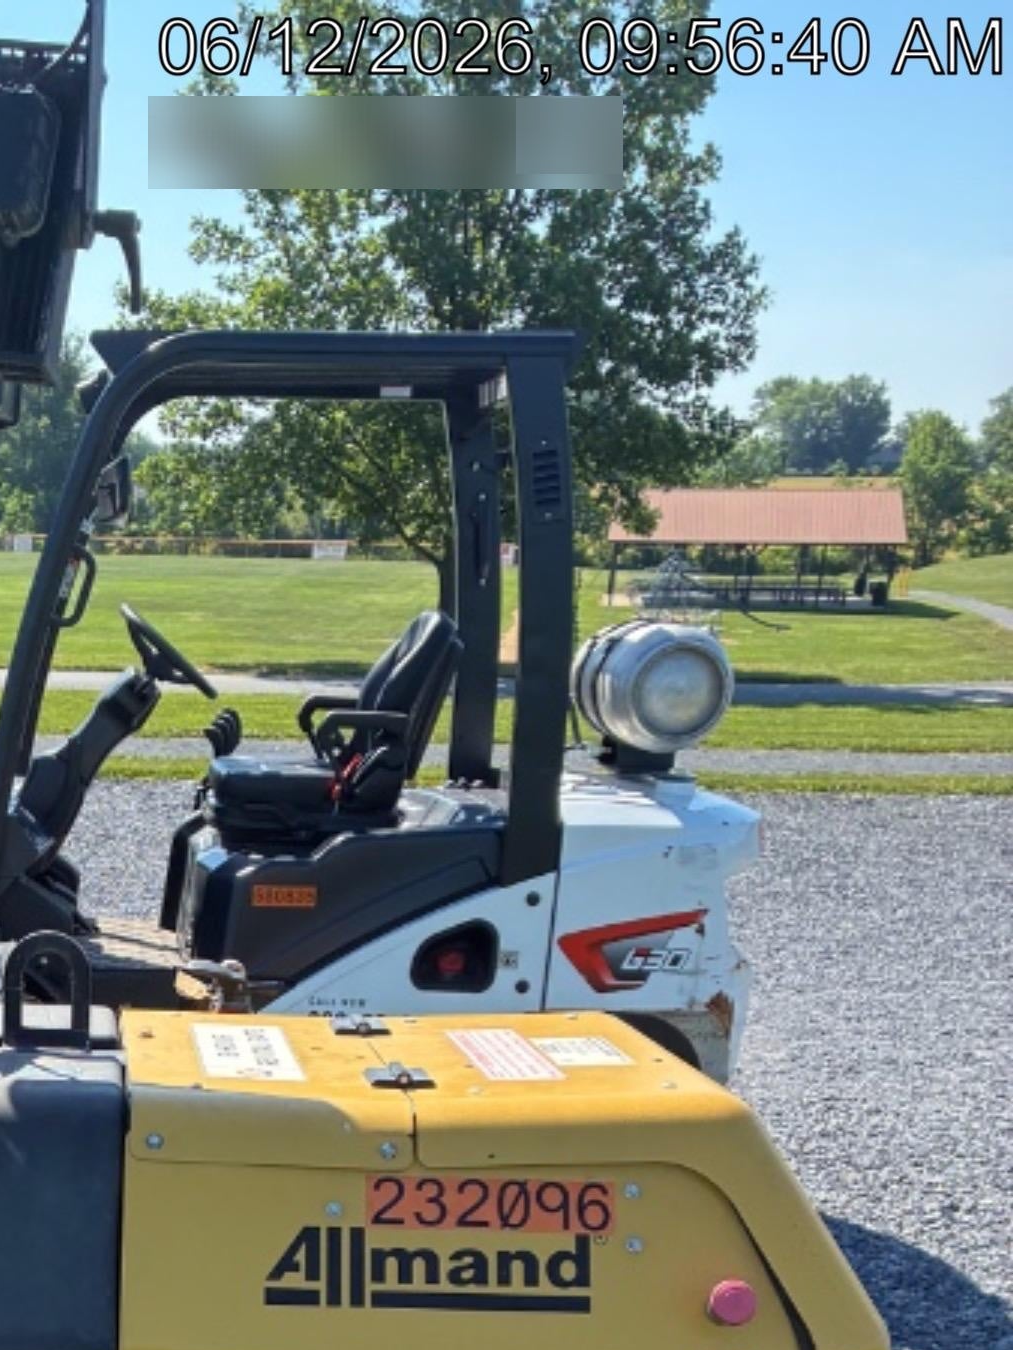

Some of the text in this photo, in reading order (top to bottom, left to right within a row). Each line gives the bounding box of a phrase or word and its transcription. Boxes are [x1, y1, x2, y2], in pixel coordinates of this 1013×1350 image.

[621, 947, 693, 971] G30
[370, 1176, 610, 1232] 232096
[264, 1225, 592, 1312] Allmand
